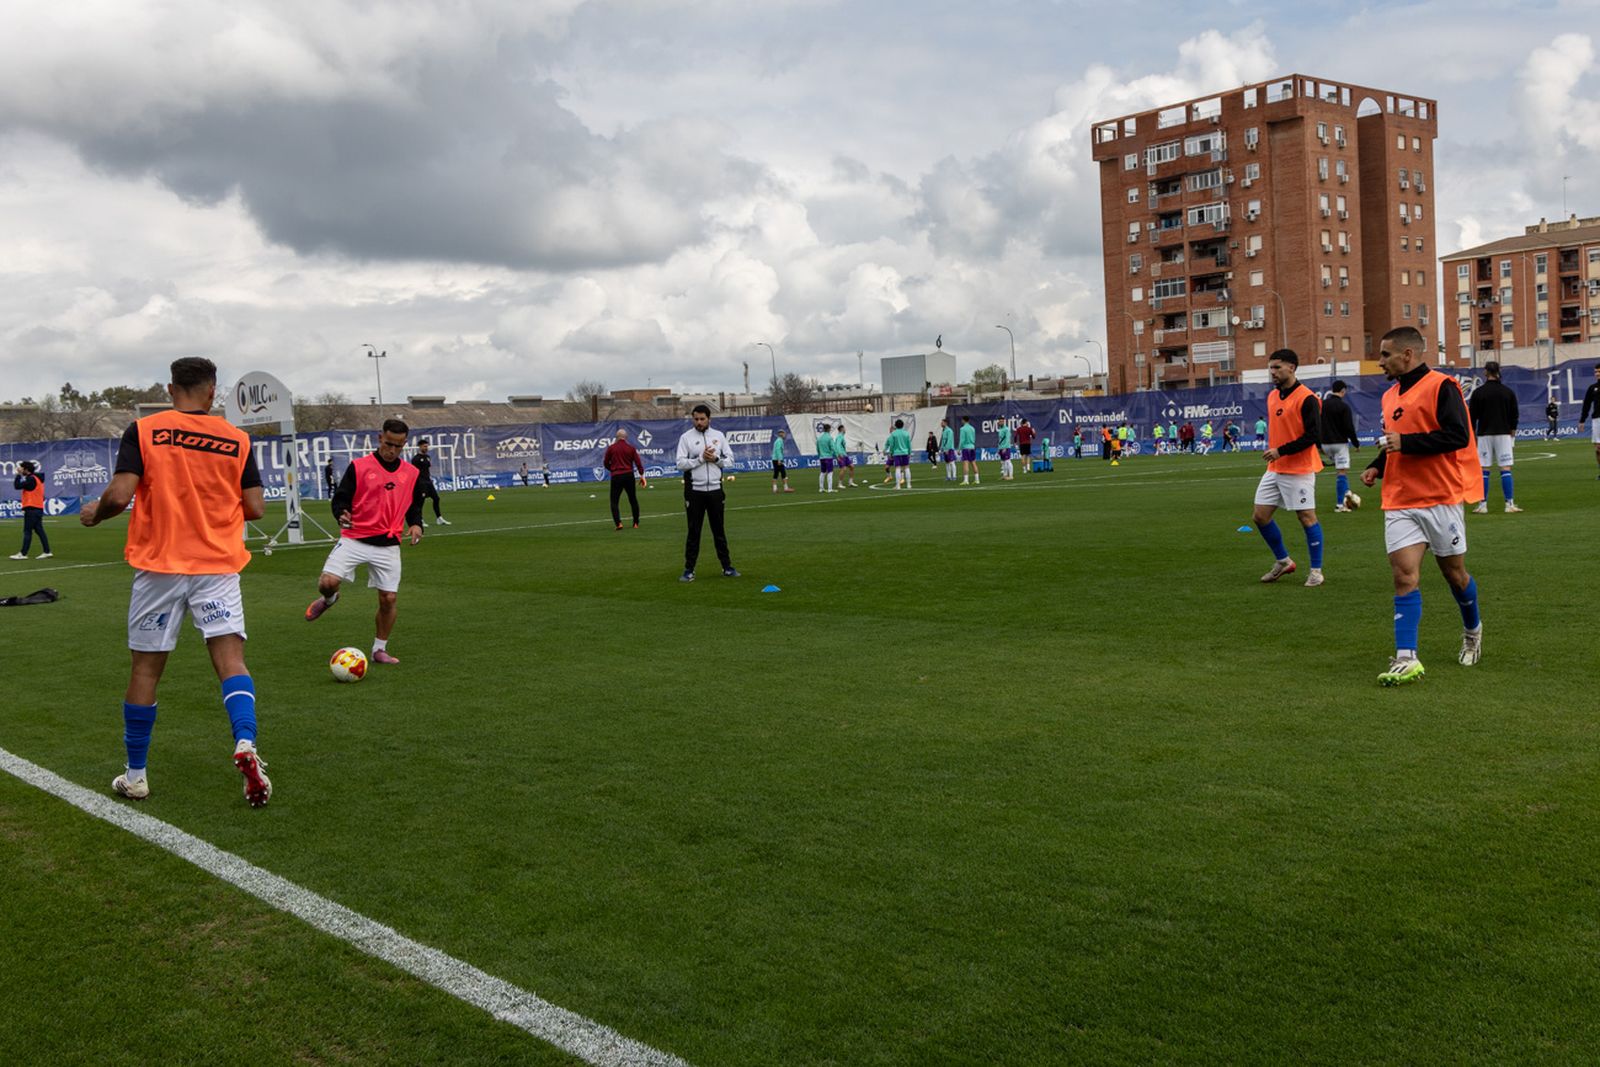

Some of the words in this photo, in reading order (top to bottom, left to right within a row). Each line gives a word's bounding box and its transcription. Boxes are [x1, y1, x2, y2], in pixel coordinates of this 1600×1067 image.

[249, 383, 269, 405] MLC
[1547, 368, 1584, 406] EL
[175, 433, 237, 453] LOTTO
[553, 439, 596, 451] DESAY
[730, 432, 757, 444] ACTIA
[253, 436, 331, 470] TURO
[402, 428, 477, 461] MPEZÓ
[747, 458, 799, 470] VENTNAS
[53, 470, 109, 481] AYUNTAMIENTO
